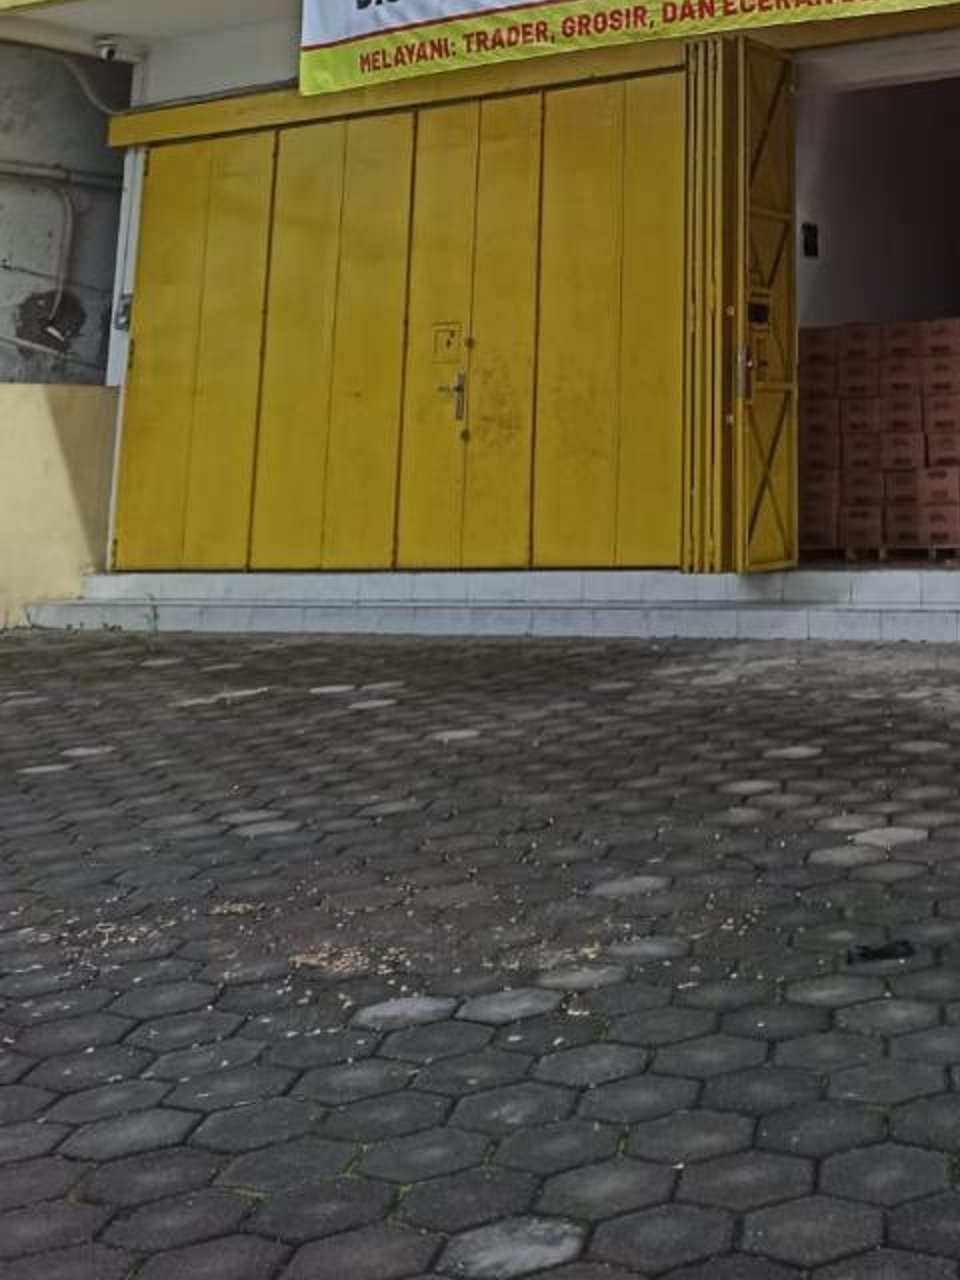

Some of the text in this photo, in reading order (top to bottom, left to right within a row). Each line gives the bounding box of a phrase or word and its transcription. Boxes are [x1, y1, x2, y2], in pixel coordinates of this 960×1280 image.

[359, 38, 456, 73] MELAYANI:
[463, 20, 554, 54] TRADER,
[561, 4, 654, 39] GROSIR,
